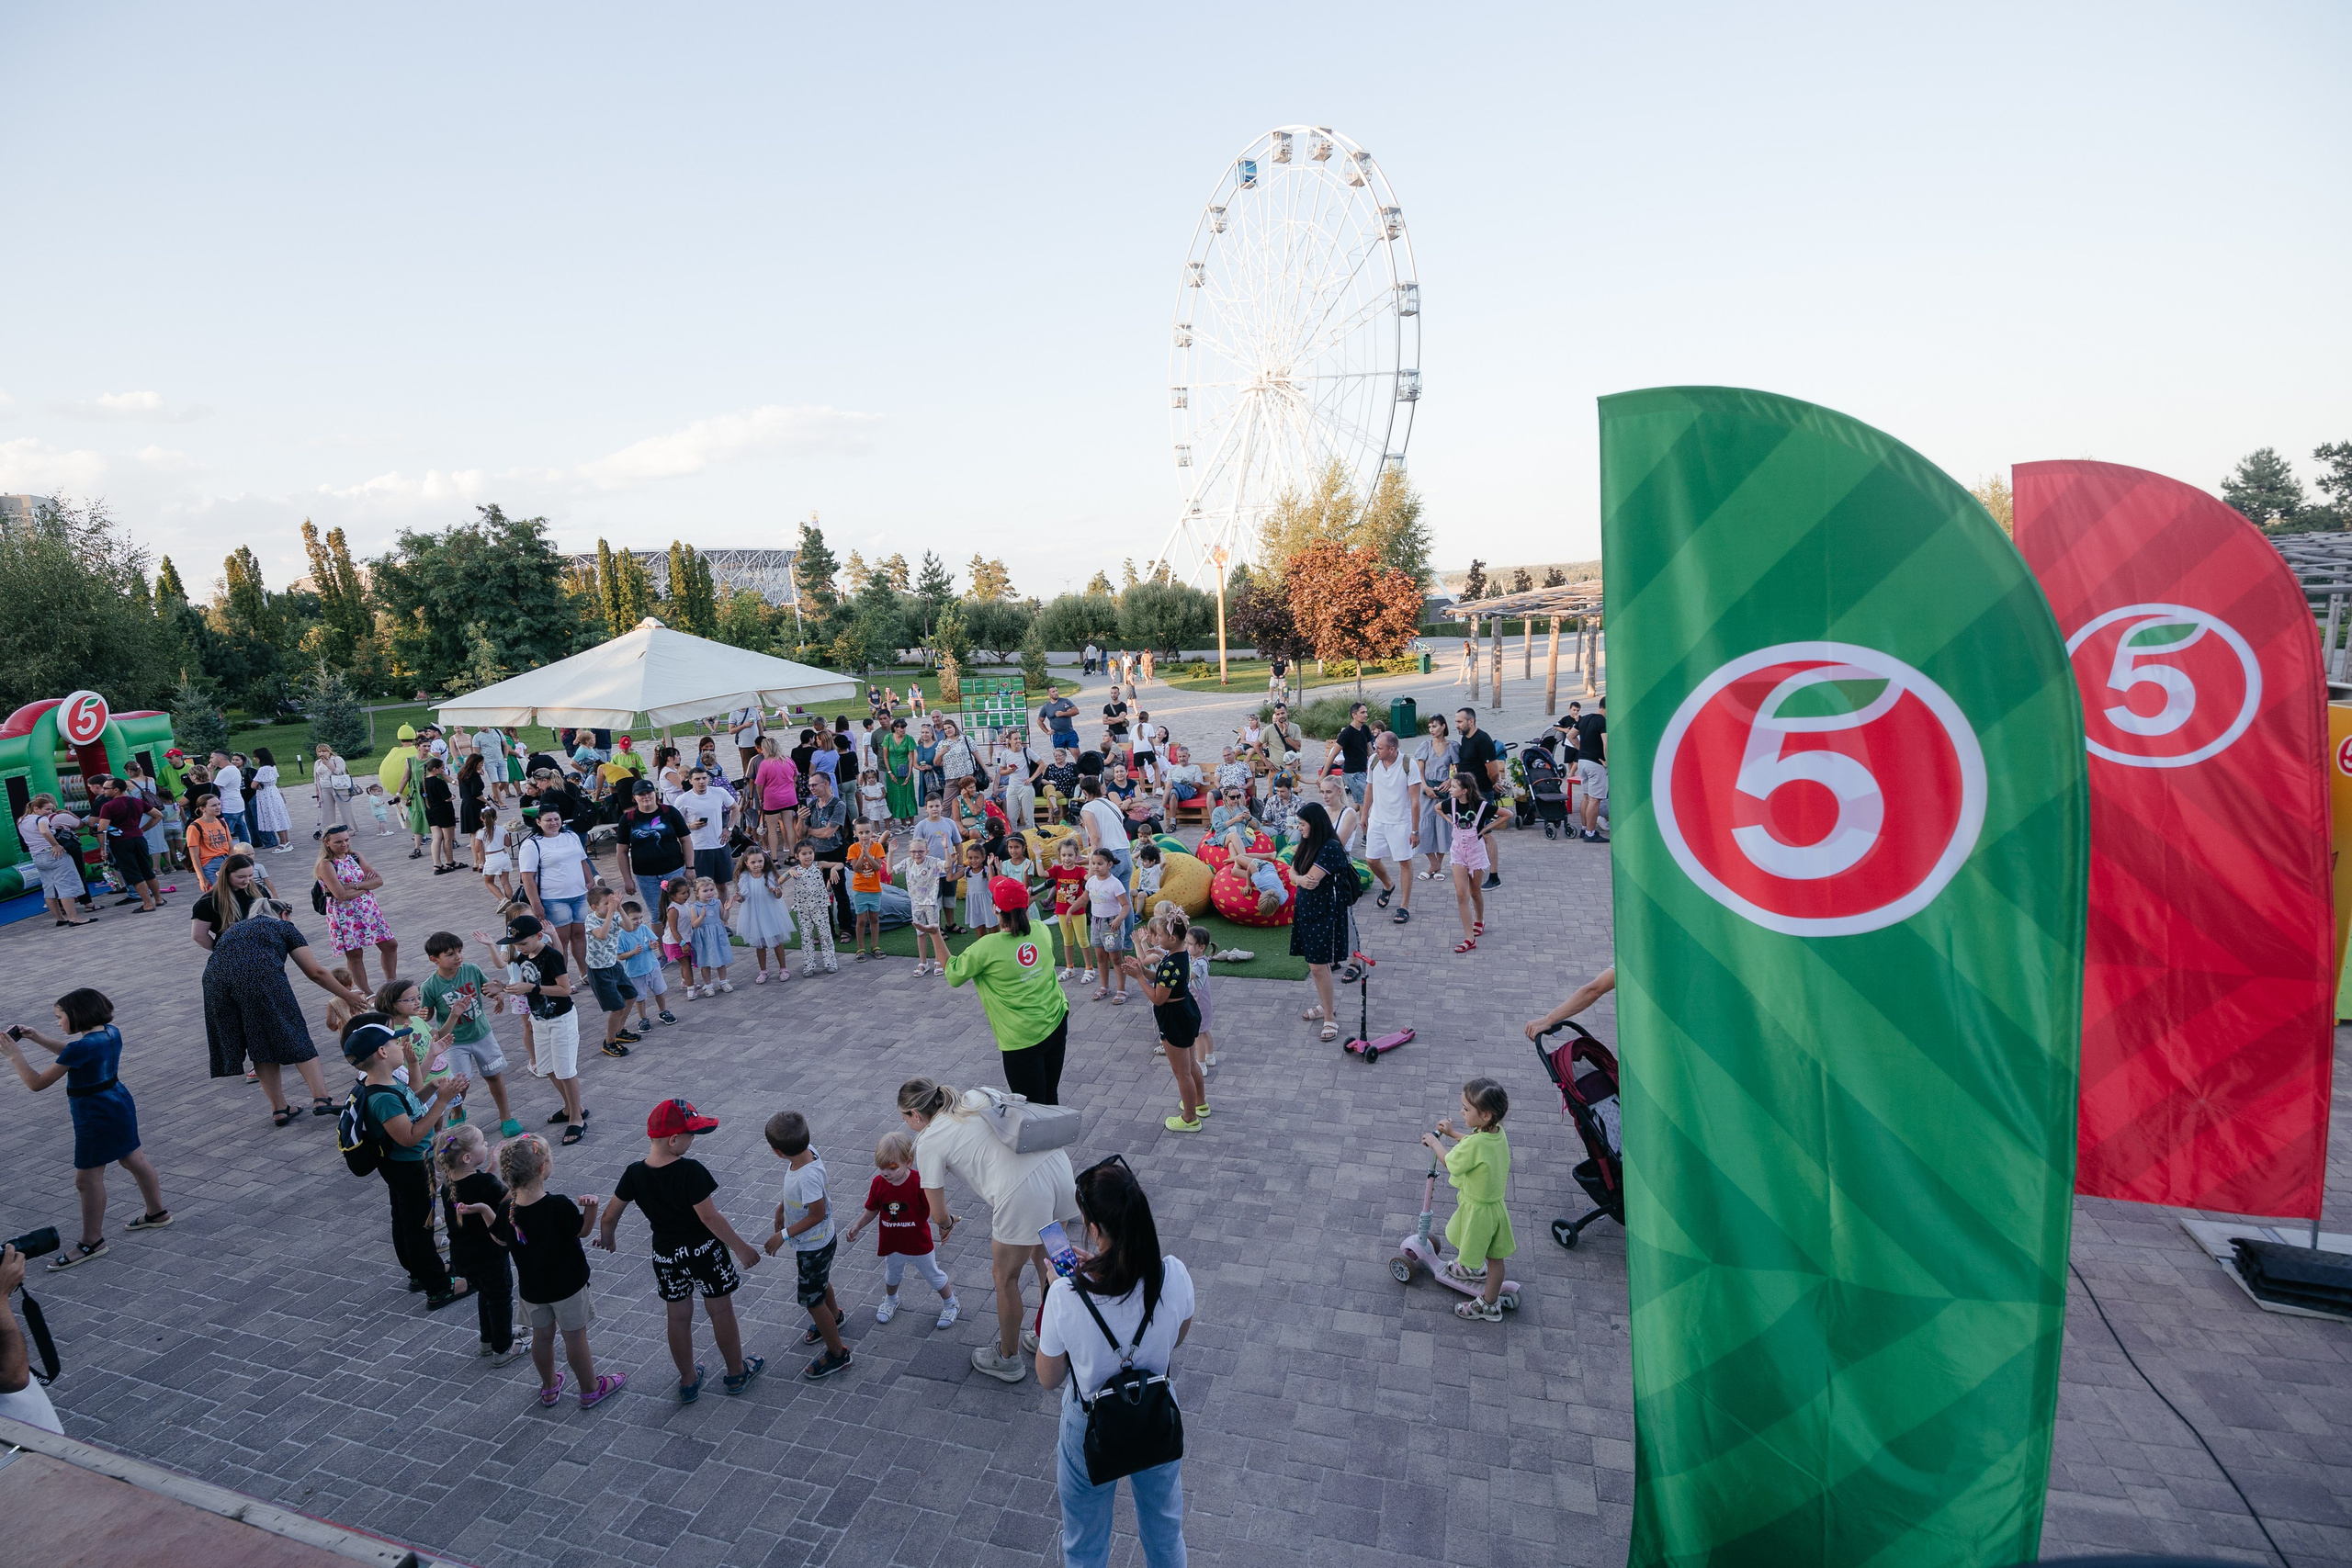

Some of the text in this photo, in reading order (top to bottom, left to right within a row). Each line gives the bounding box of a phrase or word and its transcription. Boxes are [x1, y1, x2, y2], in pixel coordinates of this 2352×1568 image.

[76, 697, 100, 735] 5
[2103, 616, 2209, 738] 5
[1730, 665, 1905, 880] 5
